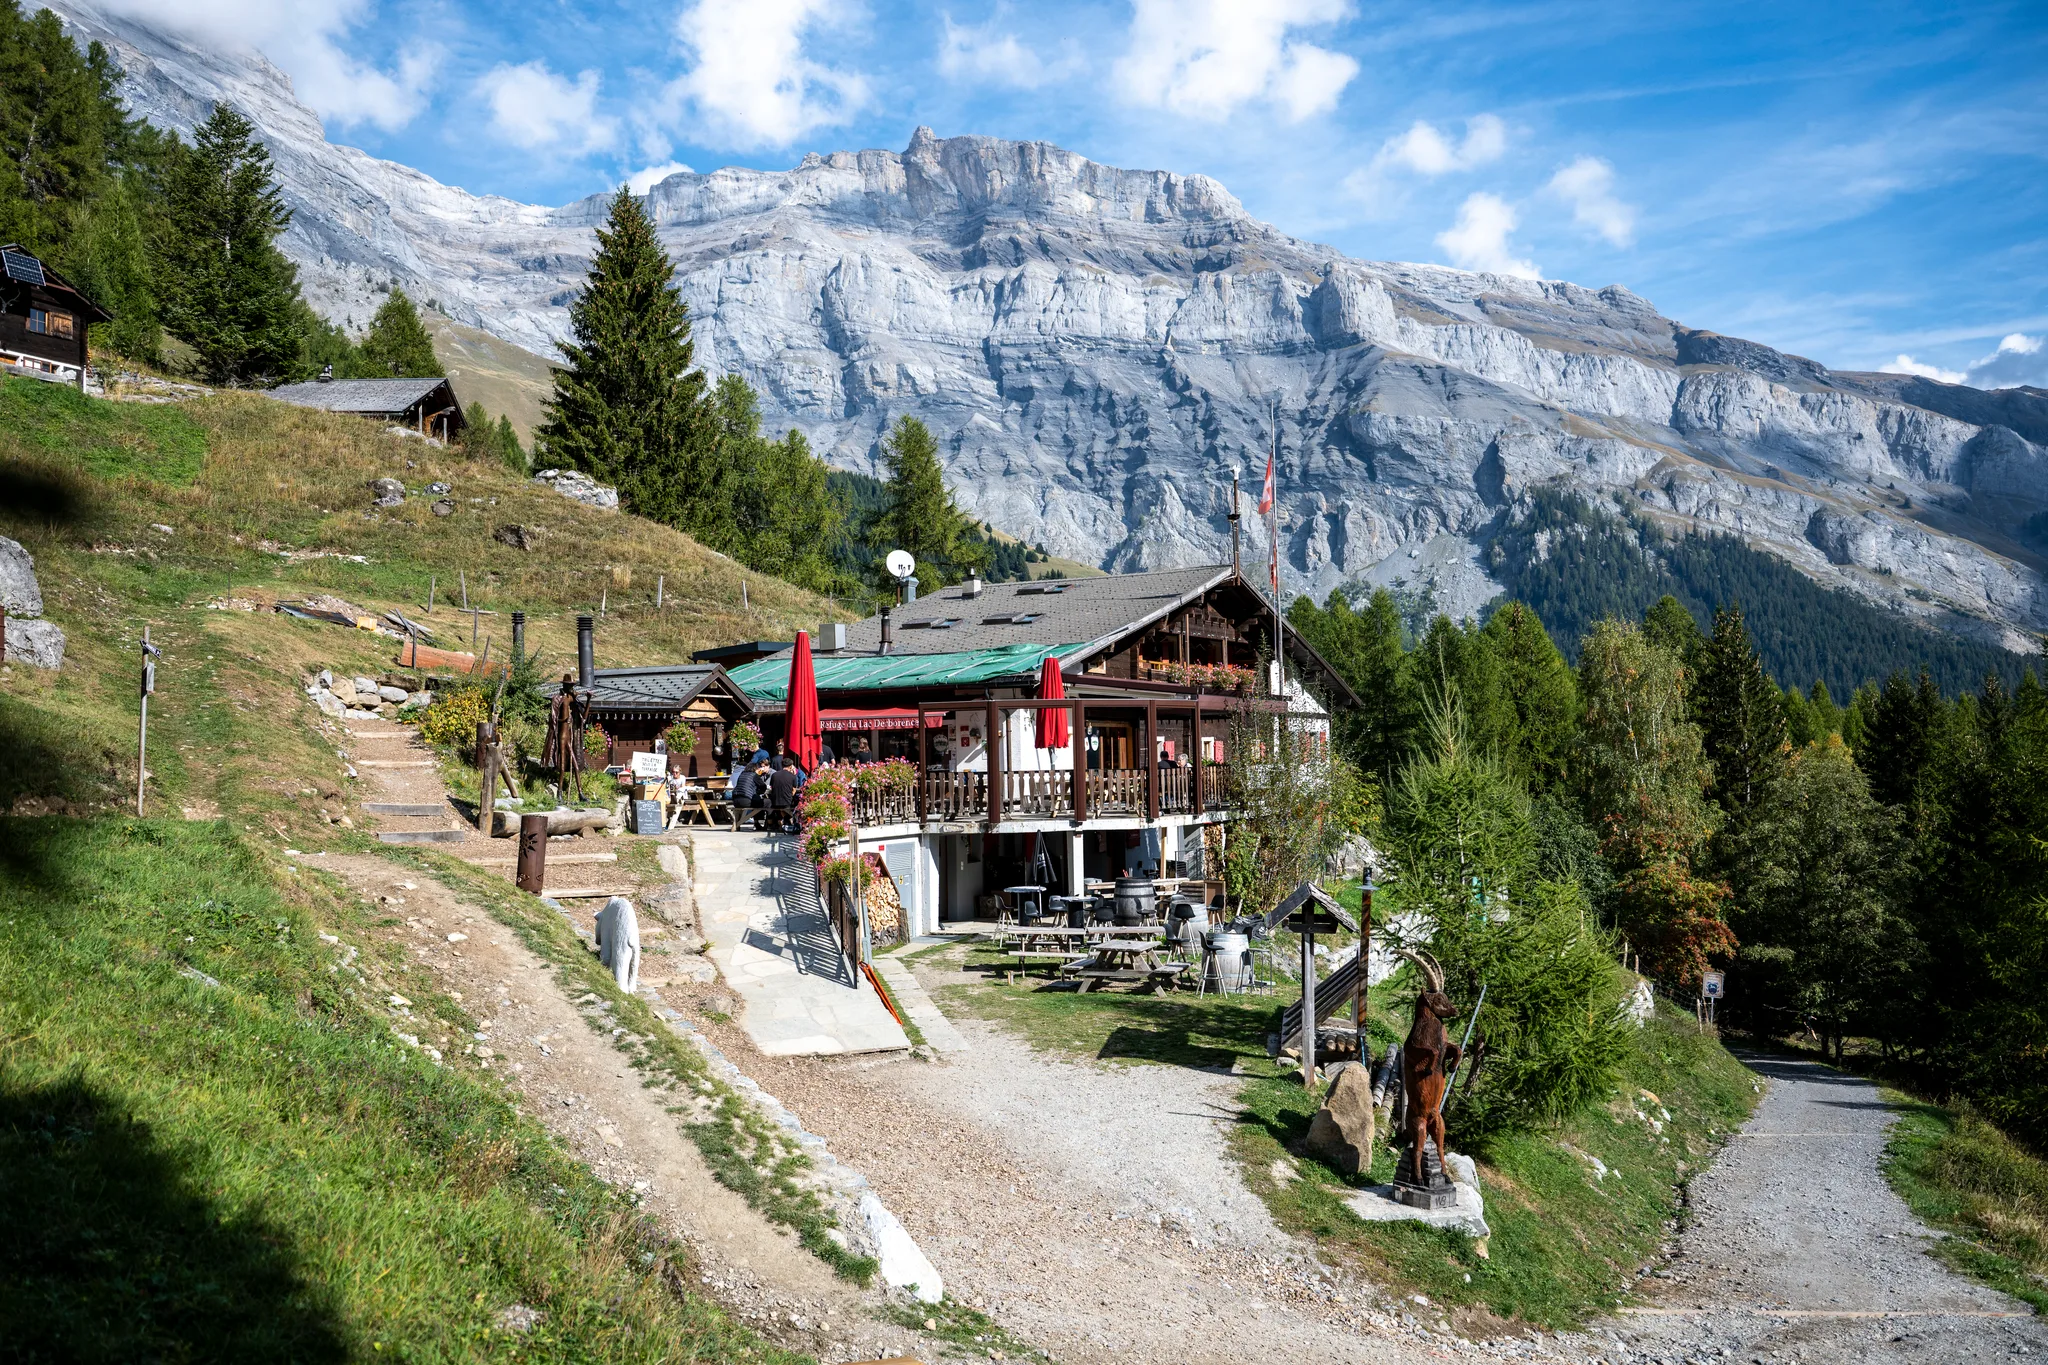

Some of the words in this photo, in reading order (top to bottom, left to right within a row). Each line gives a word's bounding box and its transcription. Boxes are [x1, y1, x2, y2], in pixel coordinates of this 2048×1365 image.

[820, 720, 845, 730] Refuge
[847, 720, 857, 728] du
[859, 720, 872, 728] Lac
